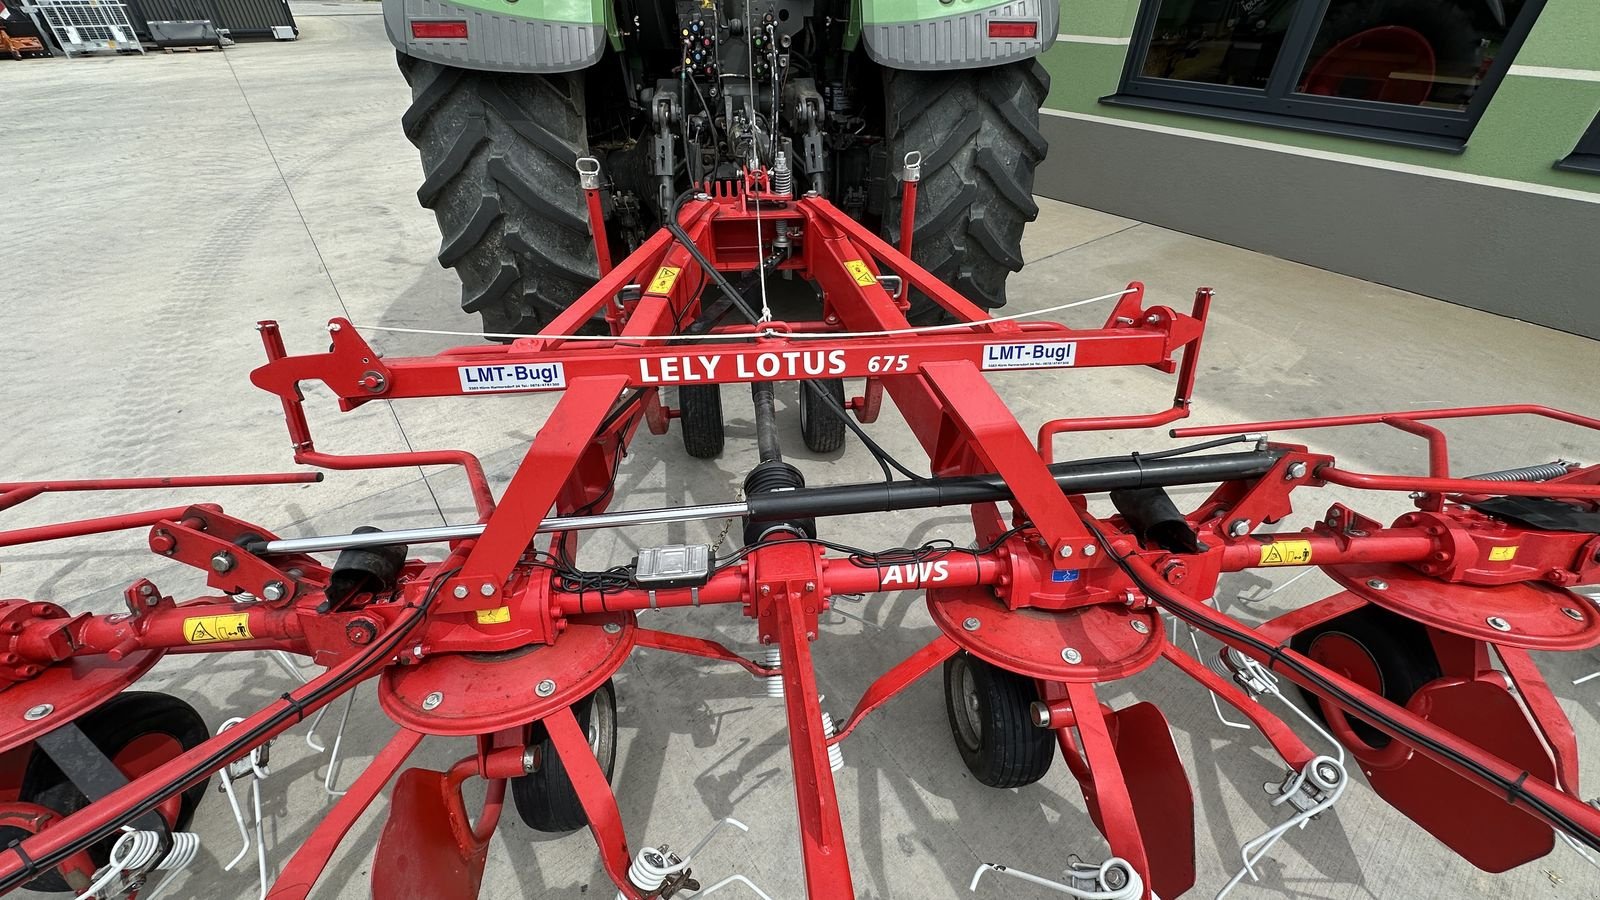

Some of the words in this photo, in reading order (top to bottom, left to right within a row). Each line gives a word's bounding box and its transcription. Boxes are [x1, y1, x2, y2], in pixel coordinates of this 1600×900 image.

[989, 344, 1070, 361] LMT-Bugl
[465, 364, 558, 383] LMT-Bugl
[639, 355, 721, 383] LELY
[736, 349, 846, 378] LOTUS
[867, 355, 909, 373] 675
[881, 561, 949, 585] AWS
